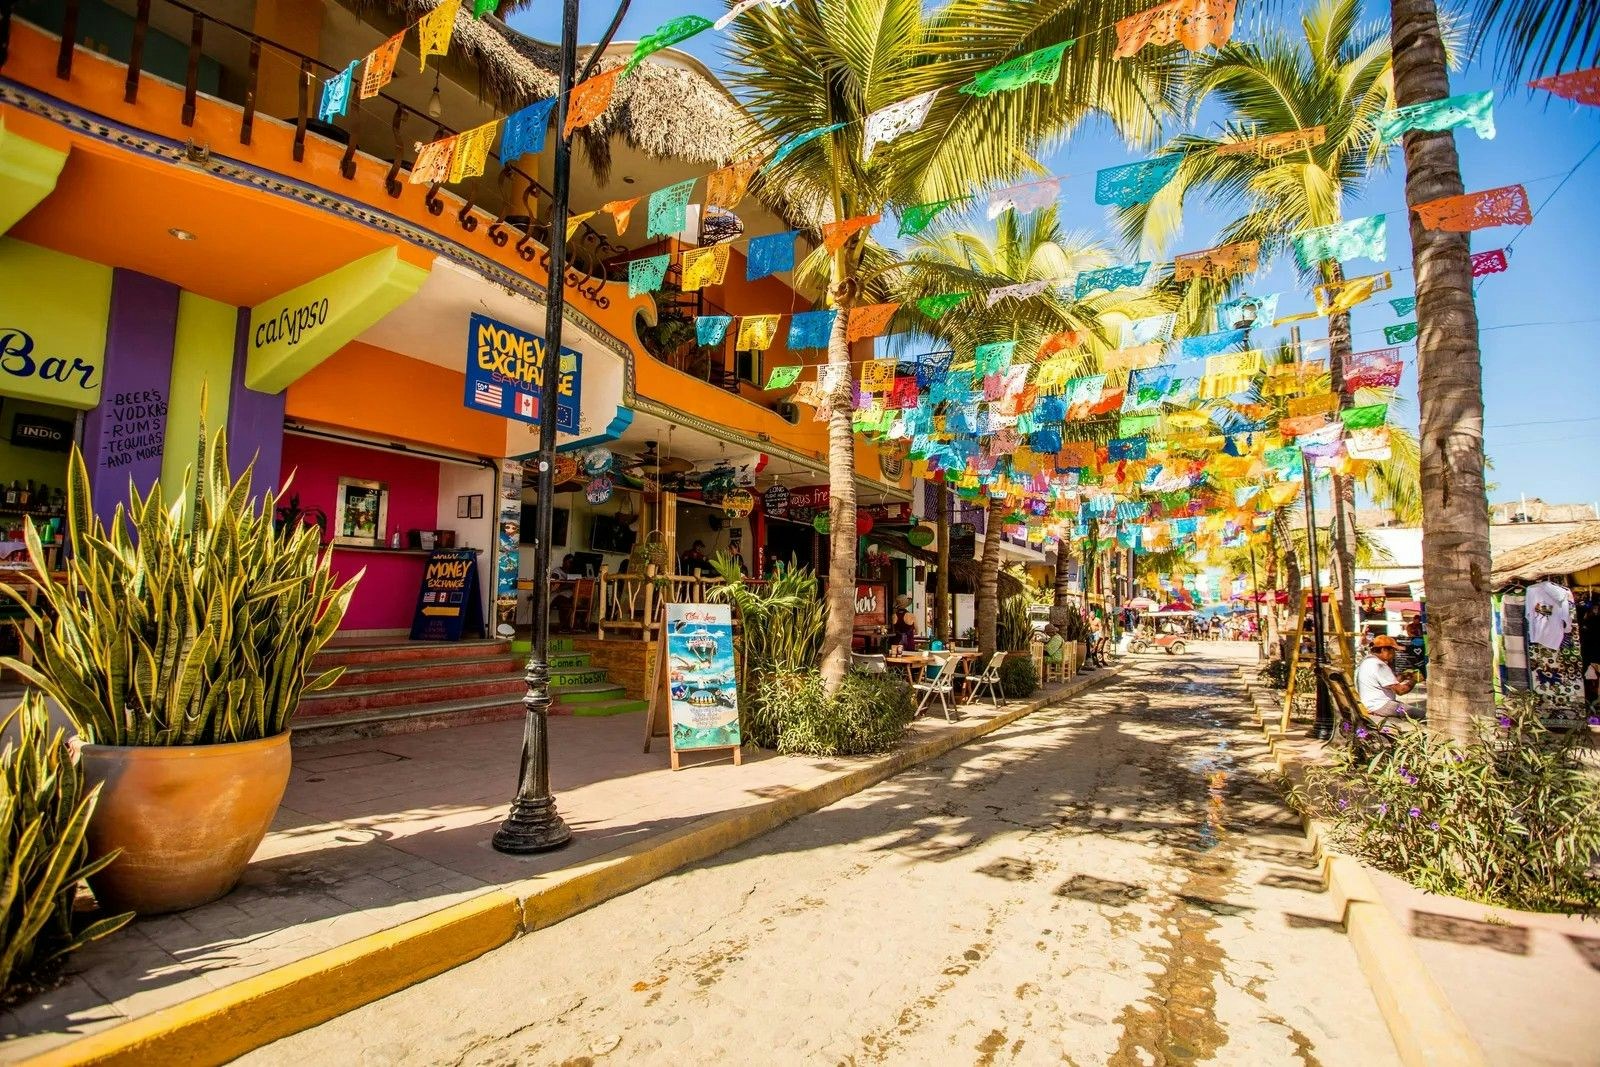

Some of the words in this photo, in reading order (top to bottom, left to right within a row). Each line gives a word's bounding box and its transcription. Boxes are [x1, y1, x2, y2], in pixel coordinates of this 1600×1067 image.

[256, 298, 328, 348] calypso
[478, 324, 546, 368] MONEY
[0, 328, 99, 389] Bar
[23, 426, 61, 440] INDIO
[136, 445, 163, 461] MORE
[426, 561, 472, 580] MONEY
[427, 579, 464, 588] EXCHANGE
[549, 659, 573, 668] Come
